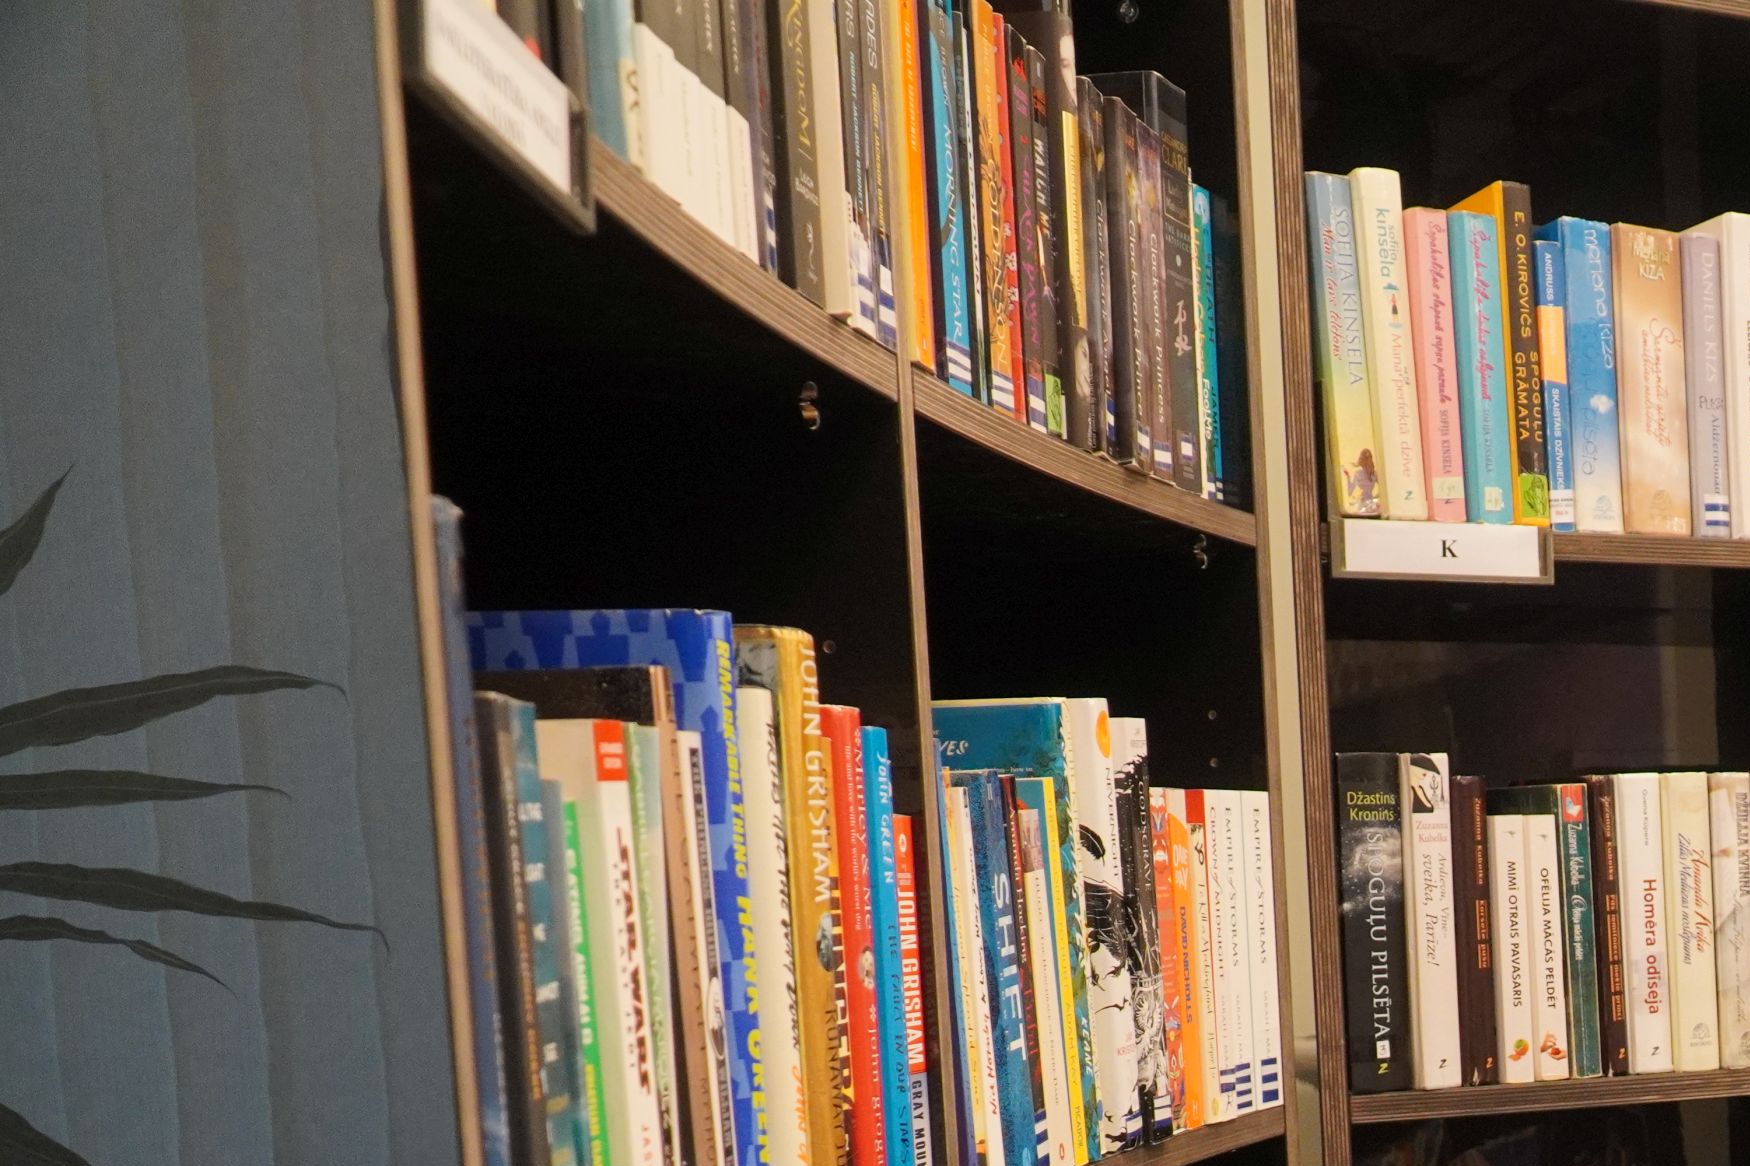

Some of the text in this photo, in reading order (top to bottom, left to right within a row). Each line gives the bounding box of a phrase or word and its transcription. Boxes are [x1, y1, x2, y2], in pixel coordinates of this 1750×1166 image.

[1375, 208, 1392, 277] kinsela
[1544, 253, 1555, 301] ANDRUSS
[951, 273, 963, 337] STAR
[1333, 207, 1364, 385] SOFIJA KINSELA
[1515, 352, 1530, 440] GRĀMATA
[1551, 388, 1562, 437] SKAISTAIS
[1439, 535, 1460, 561] K
[799, 644, 833, 904] JOHN GRISHAM
[1347, 791, 1395, 805] Džastins
[730, 803, 748, 879] THING
[1366, 832, 1391, 1038] SPOGUĻU PILSĒTA
[1506, 861, 1523, 1007] MIMĪ OTRAIS PAVASARIS
[1540, 868, 1557, 1009] OFĒLIJA MĀCĀS PELDĒT
[1643, 879, 1659, 946] Homēra
[897, 889, 925, 1065] JOHN GRISHAM
[993, 873, 1027, 1062] SHIFT
[912, 1080, 925, 1121] GRAY
